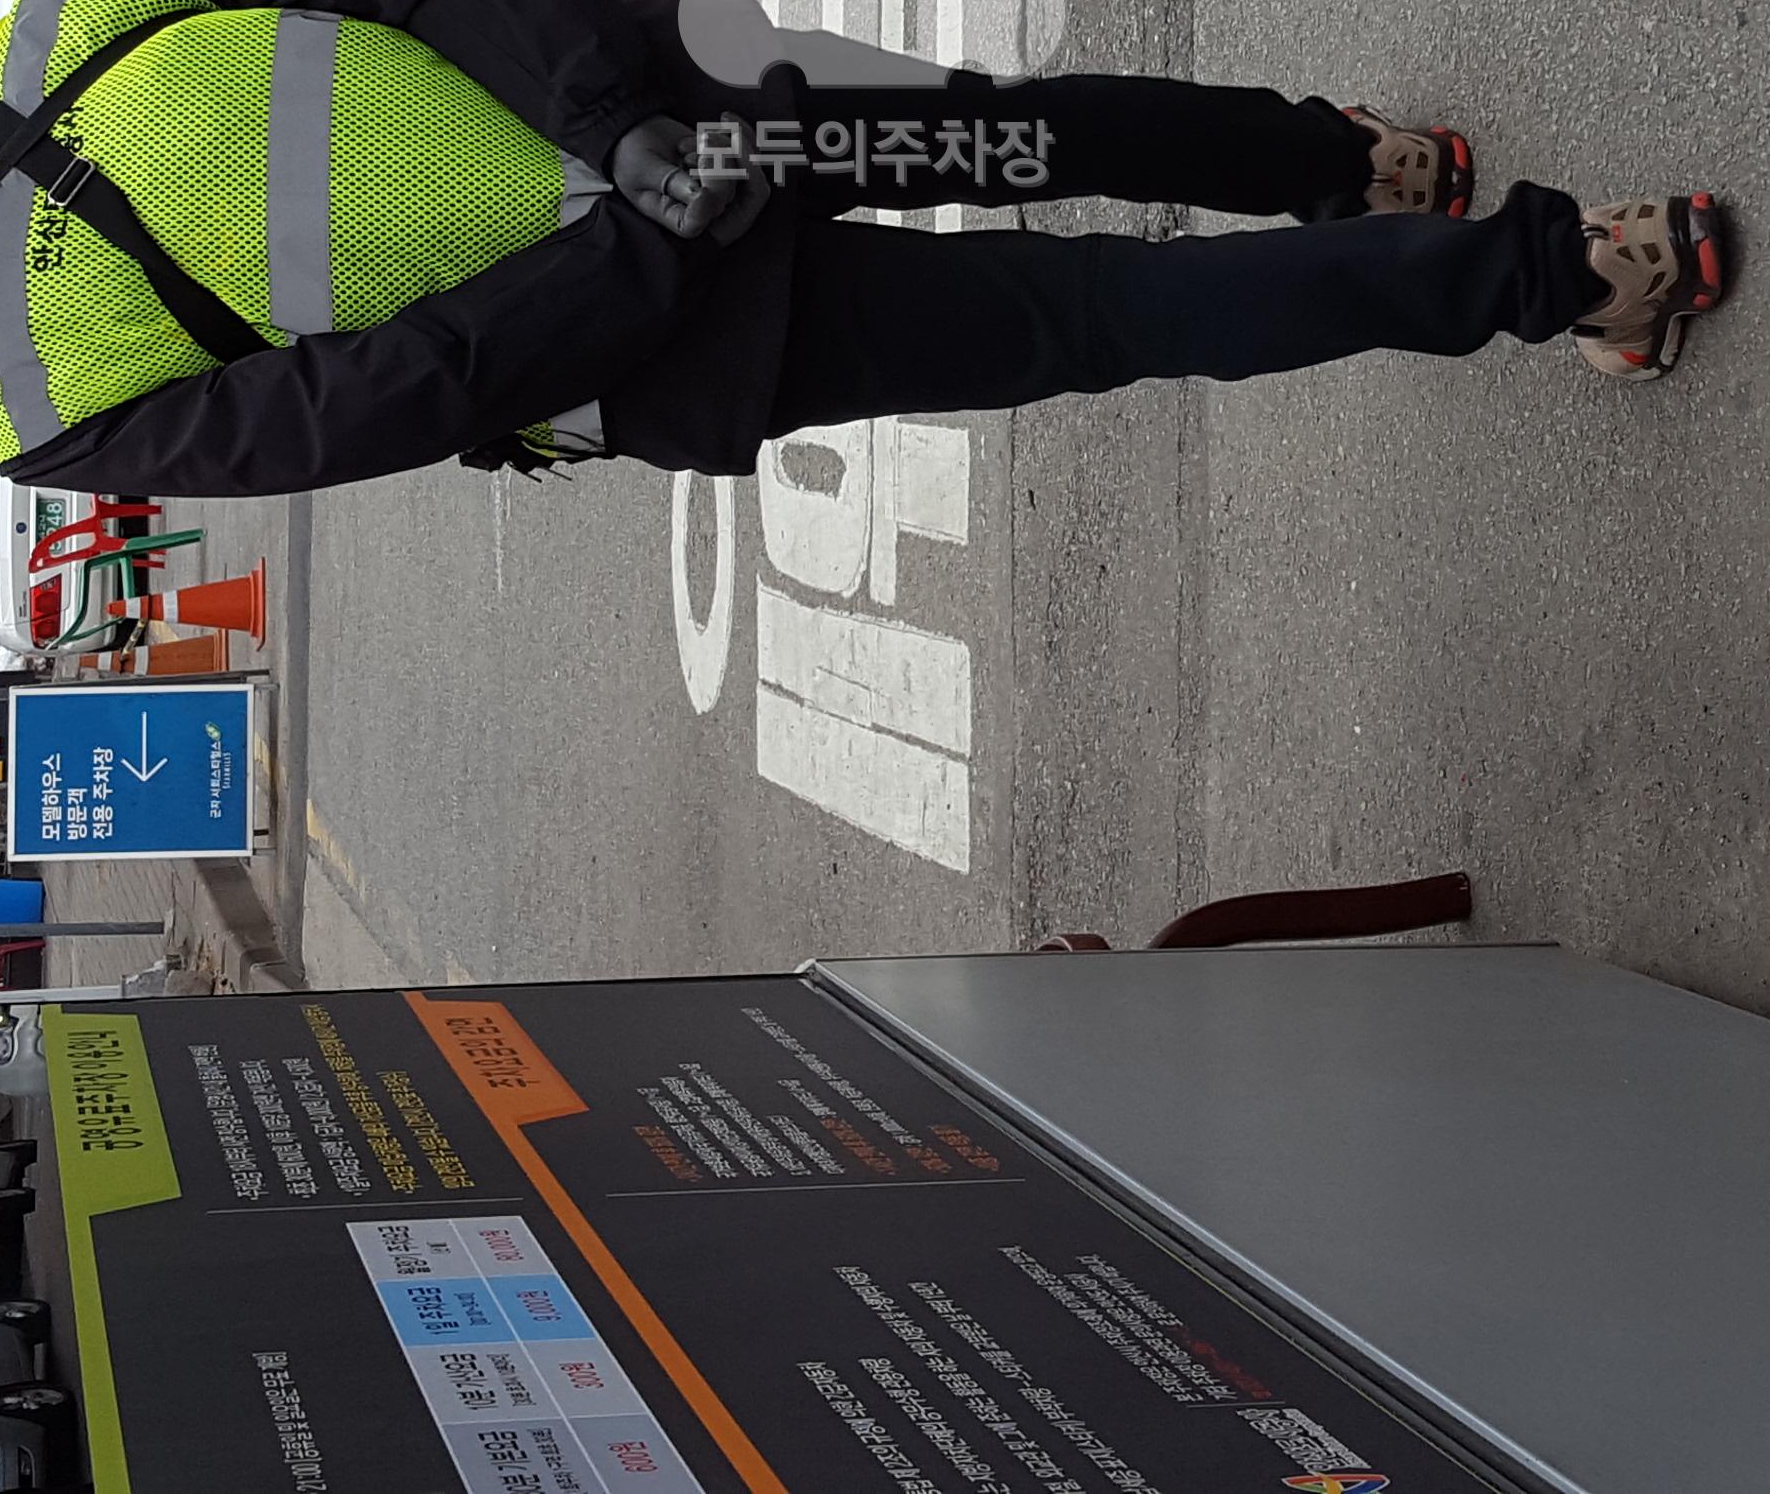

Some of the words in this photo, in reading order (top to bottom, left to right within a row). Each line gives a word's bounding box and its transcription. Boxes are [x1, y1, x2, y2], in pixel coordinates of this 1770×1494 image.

[93, 746, 113, 801] 주차장
[41, 753, 61, 841] 모델하우스
[67, 788, 88, 841] 방문객
[93, 804, 113, 839] 전용
[442, 1017, 502, 1036] 감면
[62, 1030, 126, 1070] 이용안내
[461, 1037, 541, 1089] 주차요금의
[67, 1073, 145, 1151] 공영유료주차장
[375, 1226, 421, 1253] 주차요금
[828, 1266, 882, 1286] 자동차
[404, 1288, 455, 1321] 주차요금
[513, 1291, 564, 1322] 9,000원
[421, 1322, 461, 1335] 1일
[881, 1321, 936, 1341] 자동차
[440, 1354, 491, 1389] 가산요금
[558, 1363, 607, 1389] 300원
[854, 1358, 917, 1389] 관용차량
[917, 1357, 966, 1372] 하는
[259, 1371, 296, 1388] 무료
[792, 1362, 859, 1400] 긴급자동차
[932, 1373, 990, 1396] 활동을
[265, 1389, 308, 1422] 일요일은
[458, 1391, 501, 1410] 10분
[826, 1401, 875, 1418] 의한
[883, 1390, 948, 1422] 공무수행
[956, 1397, 1015, 1422] 준하는
[1014, 1388, 1083, 1420] 부착차량
[274, 1423, 311, 1432] 및
[841, 1419, 897, 1444] 규정에
[478, 1431, 535, 1472] 기본요금
[605, 1442, 659, 1473] 600원
[864, 1445, 918, 1468] 2조의
[913, 1422, 1004, 1483] 지방자치단체의
[1010, 1452, 1070, 1478] 외교관
[289, 1464, 328, 1492] 21:00
[497, 1475, 545, 1494] 0분
